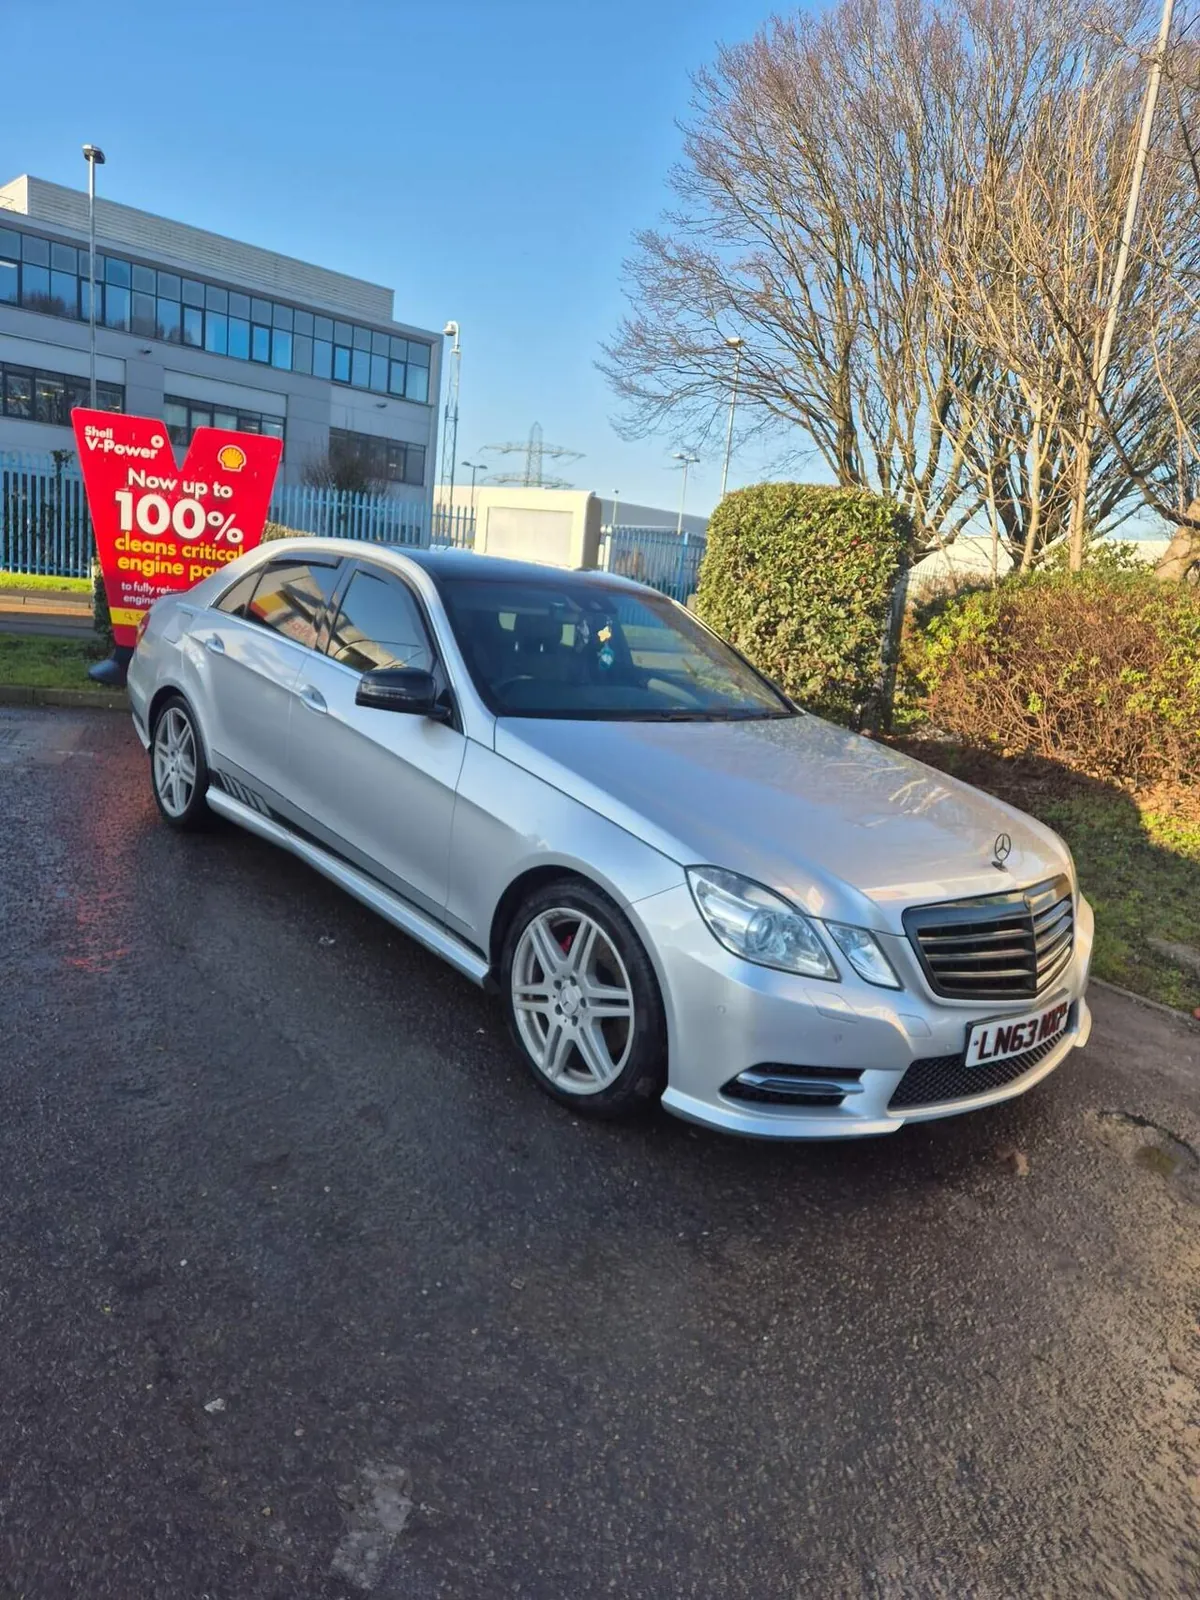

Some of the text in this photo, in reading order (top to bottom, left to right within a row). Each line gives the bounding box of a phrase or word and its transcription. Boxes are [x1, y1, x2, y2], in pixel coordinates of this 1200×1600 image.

[85, 425, 113, 439] Shell
[85, 436, 158, 459] V-Power
[128, 467, 233, 500] Now up to
[115, 490, 244, 543] 100%
[115, 532, 244, 562] cleans critical
[118, 556, 184, 577] engine
[121, 582, 132, 591] to
[133, 581, 155, 595] fully
[978, 1020, 1039, 1060] LN63
